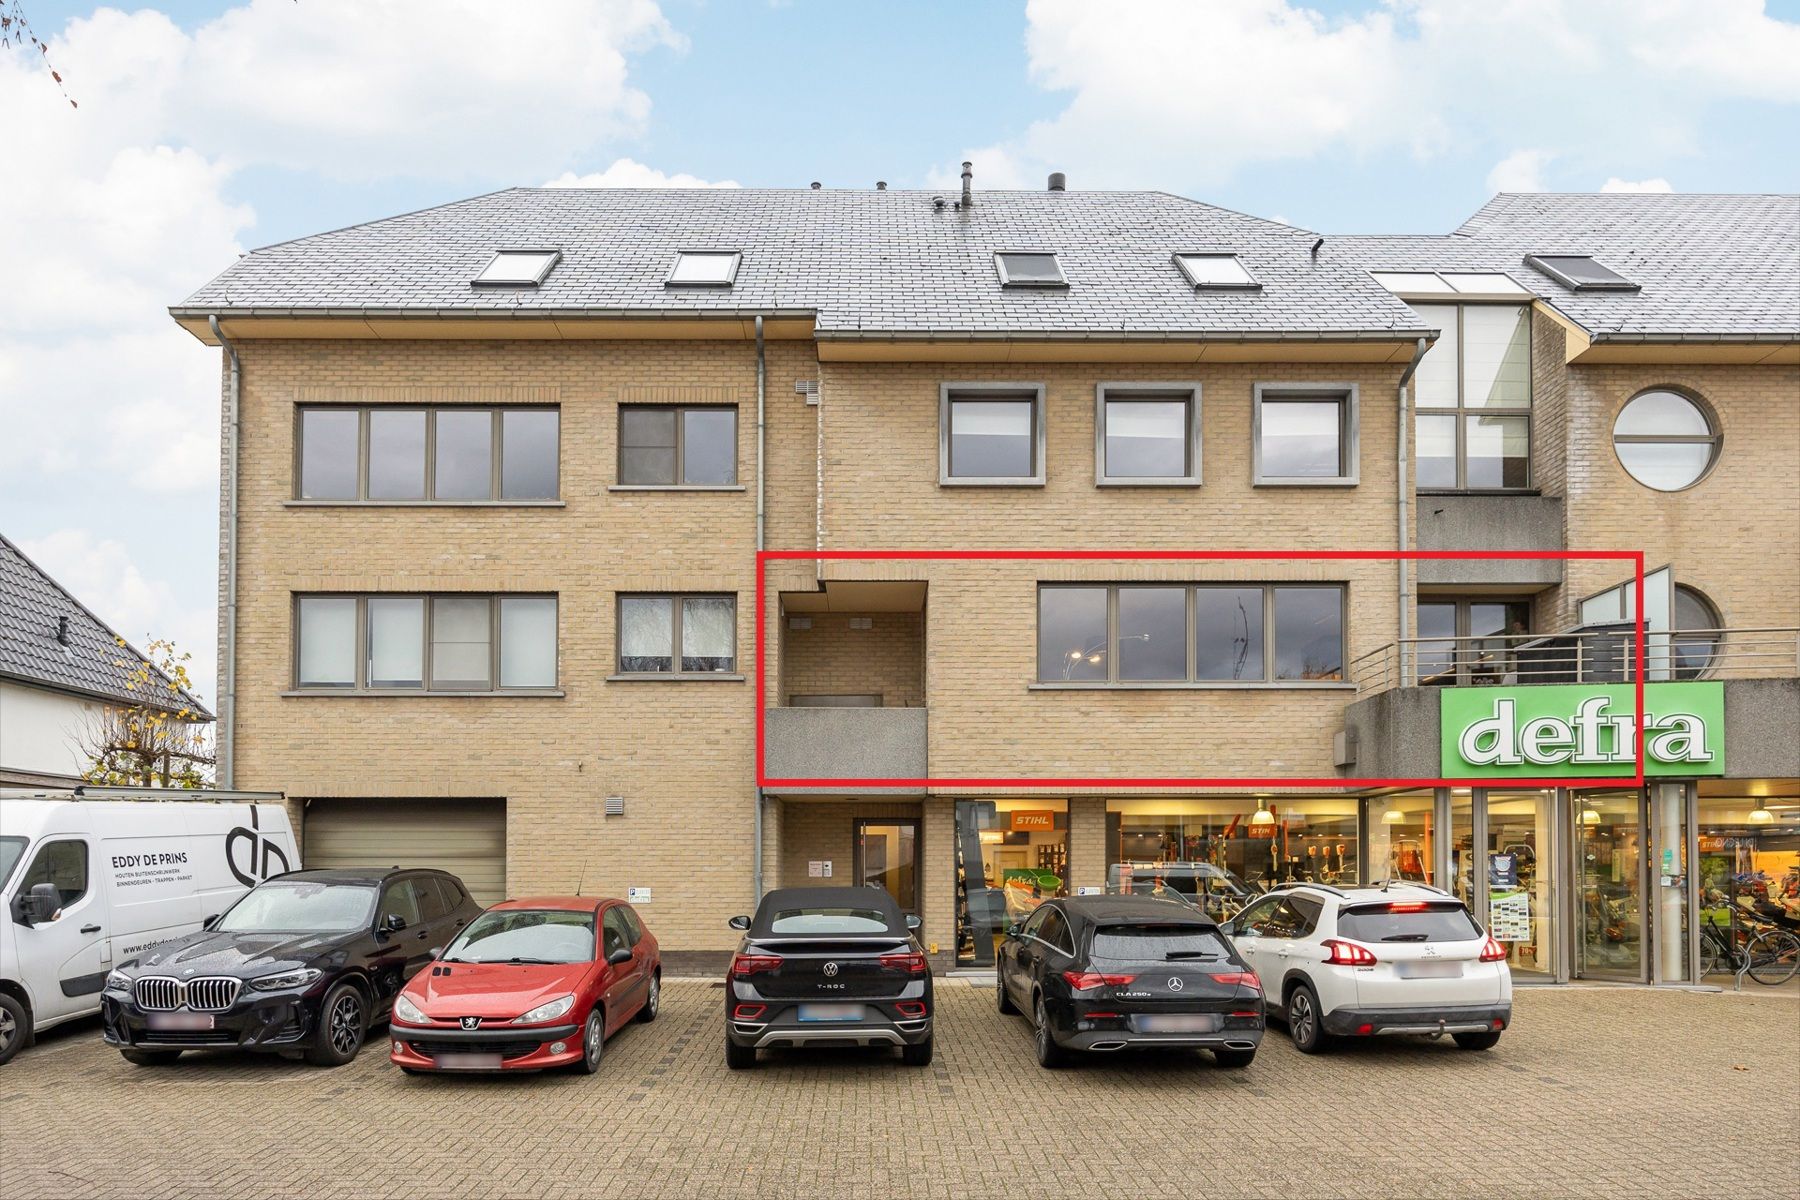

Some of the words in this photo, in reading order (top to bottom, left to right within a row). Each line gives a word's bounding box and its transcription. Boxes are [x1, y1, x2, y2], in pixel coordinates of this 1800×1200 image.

[1458, 696, 1714, 765] defra
[1016, 816, 1049, 824] STIHL
[112, 855, 141, 868] EDDY
[143, 854, 158, 866] DE
[159, 852, 188, 865] PRINS
